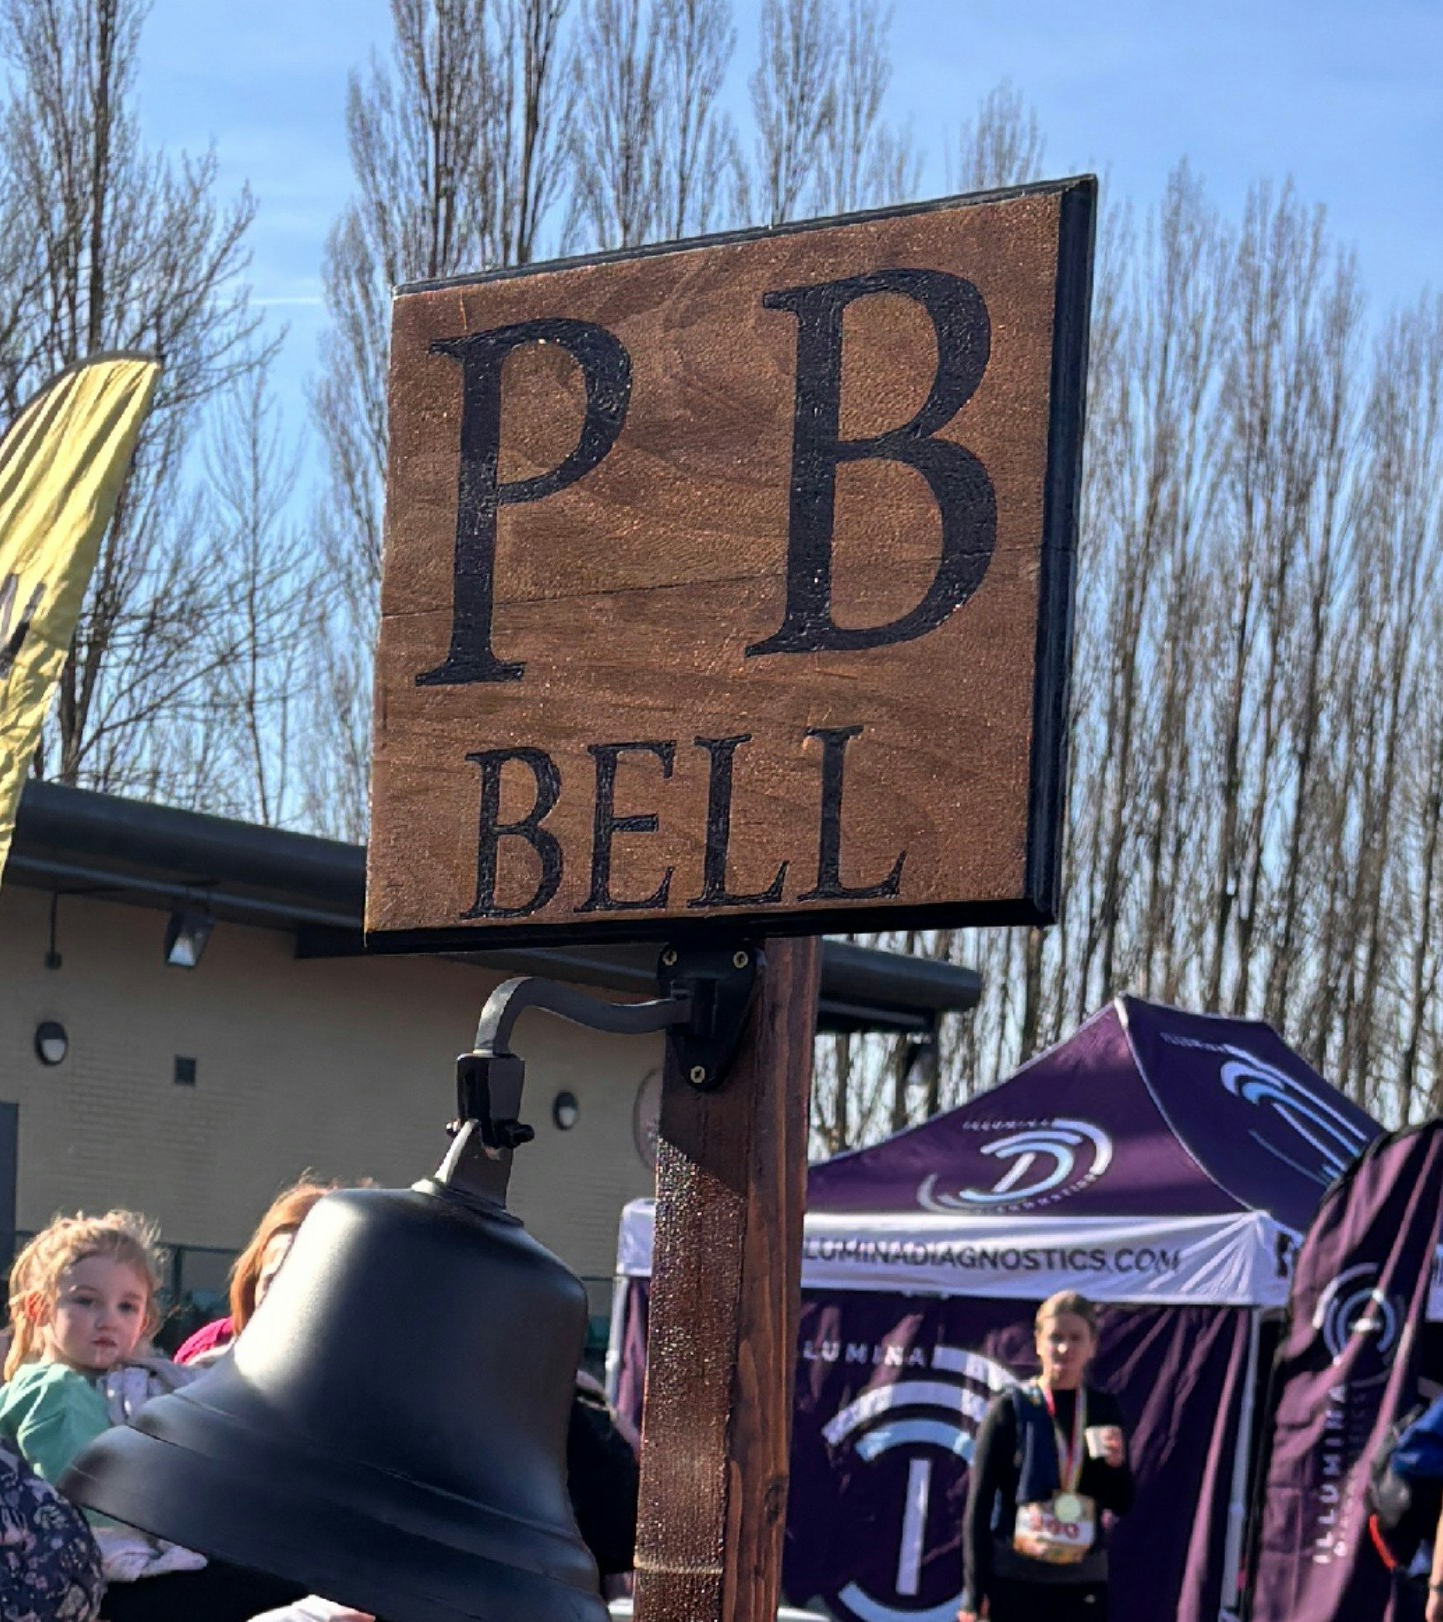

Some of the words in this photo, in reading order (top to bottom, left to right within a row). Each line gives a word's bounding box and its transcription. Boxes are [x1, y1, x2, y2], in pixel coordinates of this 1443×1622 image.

[461, 725, 907, 920] BELL
[804, 1239, 1182, 1275] LUMINADIAGNOSTICS.COM
[803, 1340, 926, 1366] LUMINA
